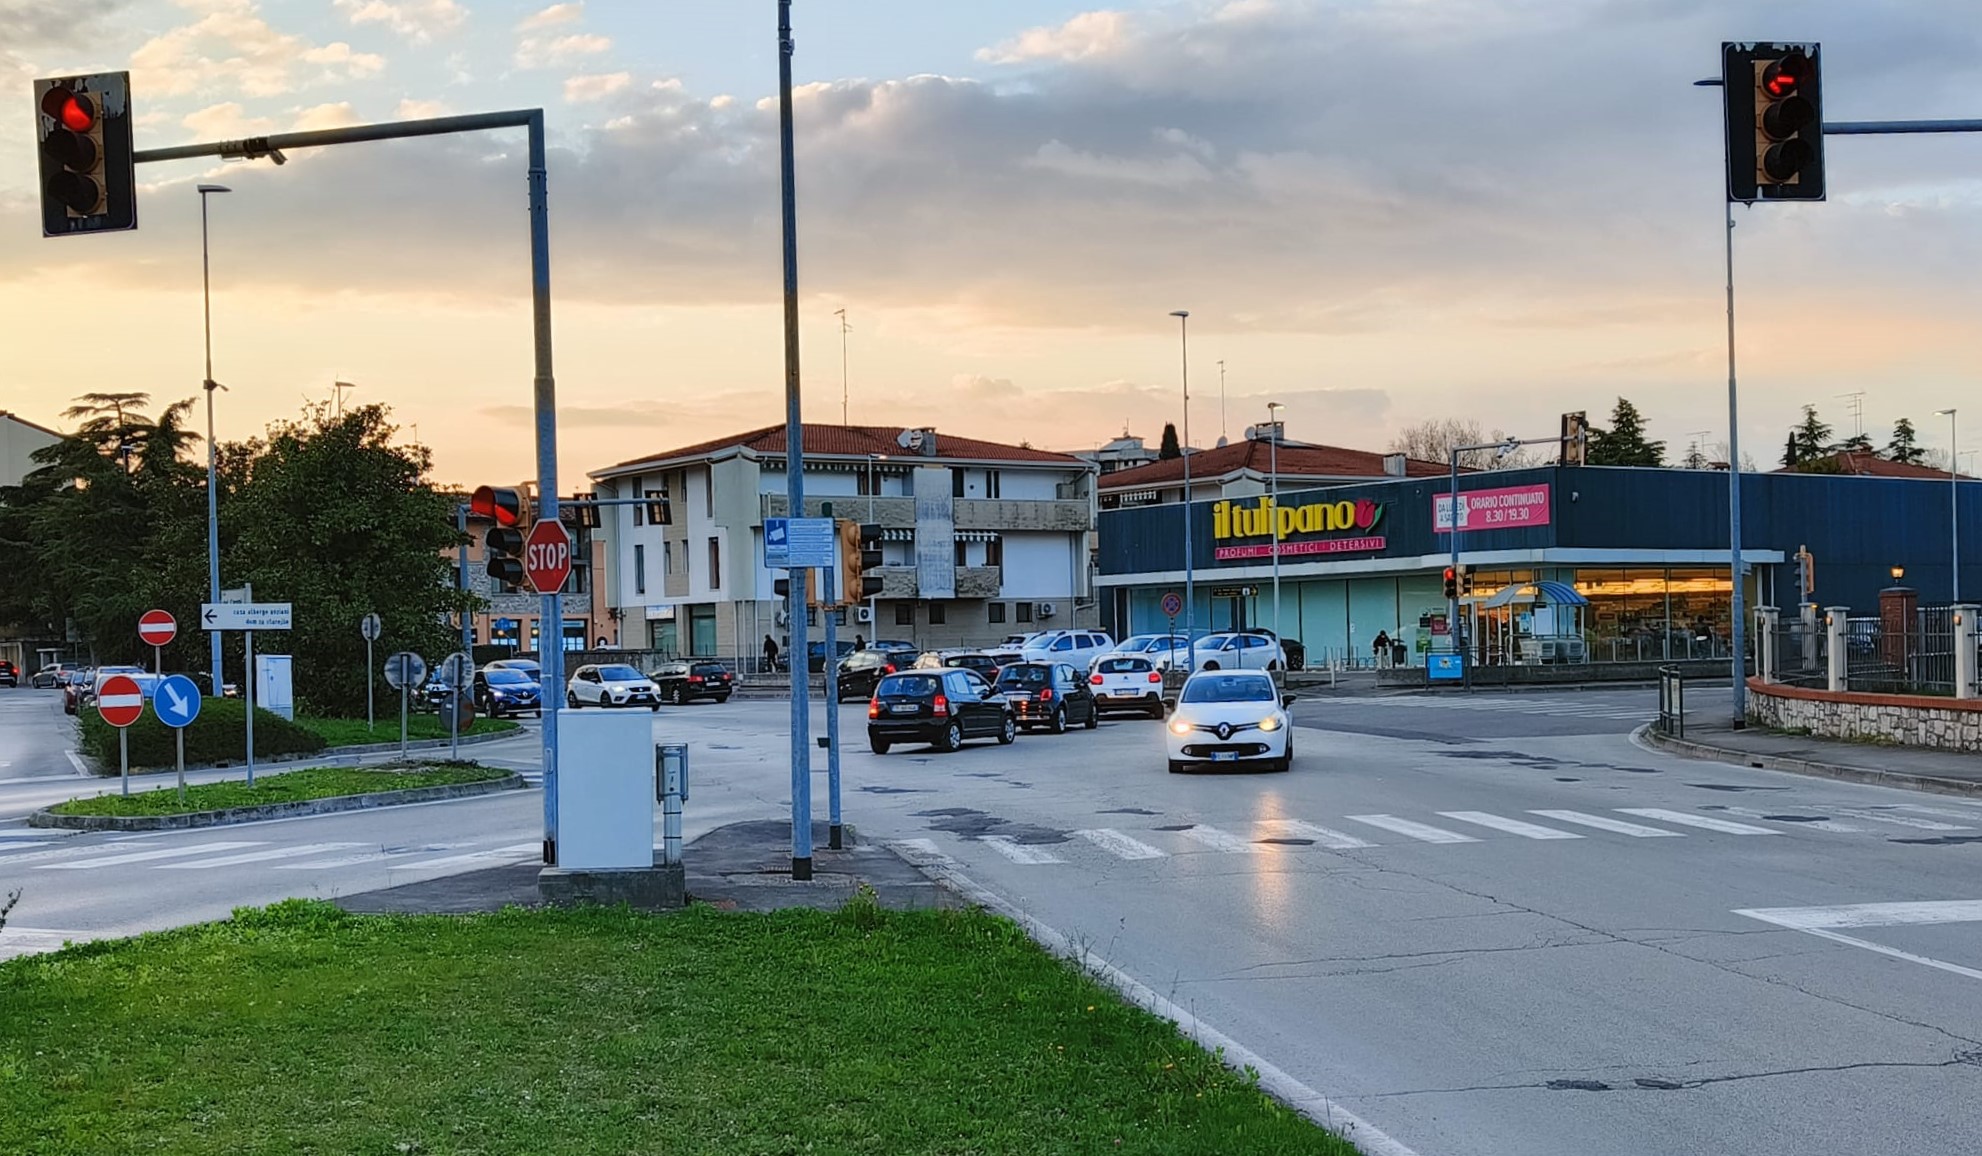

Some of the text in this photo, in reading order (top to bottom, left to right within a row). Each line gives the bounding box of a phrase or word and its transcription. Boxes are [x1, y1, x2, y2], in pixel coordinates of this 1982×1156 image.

[1471, 492, 1545, 509] ORARIO CONTINUATO
[529, 543, 567, 571] STOP
[1218, 547, 1257, 558] PROFUMI
[1330, 538, 1379, 550] DETERSIVI
